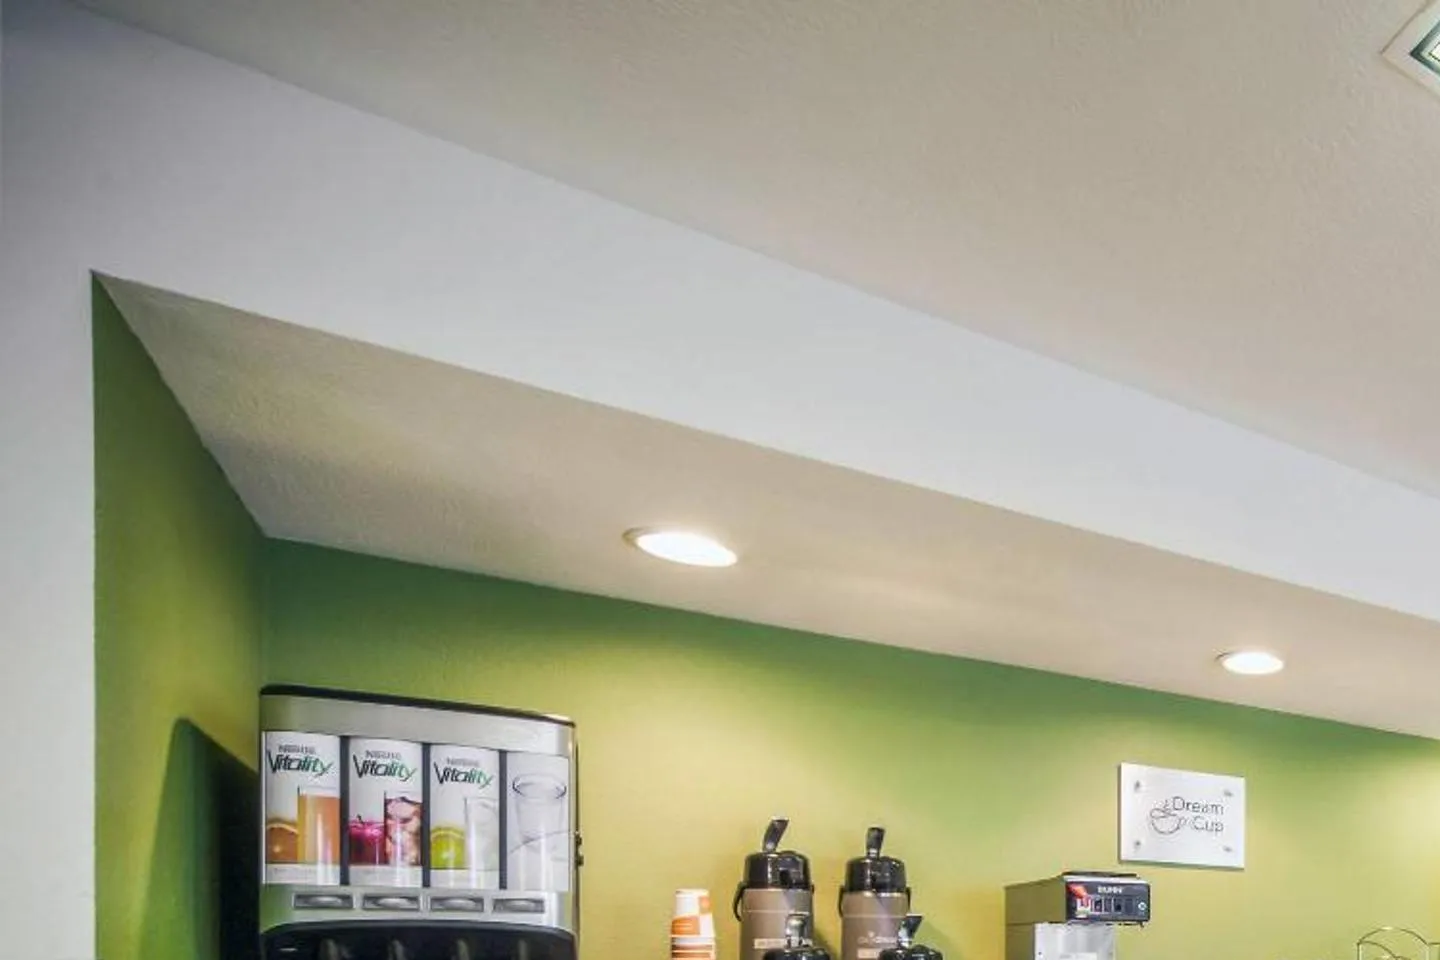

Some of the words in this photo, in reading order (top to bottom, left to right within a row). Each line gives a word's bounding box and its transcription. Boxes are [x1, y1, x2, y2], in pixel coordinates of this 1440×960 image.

[267, 750, 333, 777] Vitality
[352, 754, 417, 781] Vitality
[433, 761, 493, 789] Vitality
[1172, 796, 1224, 815] Dream
[1193, 816, 1224, 835] Cup
